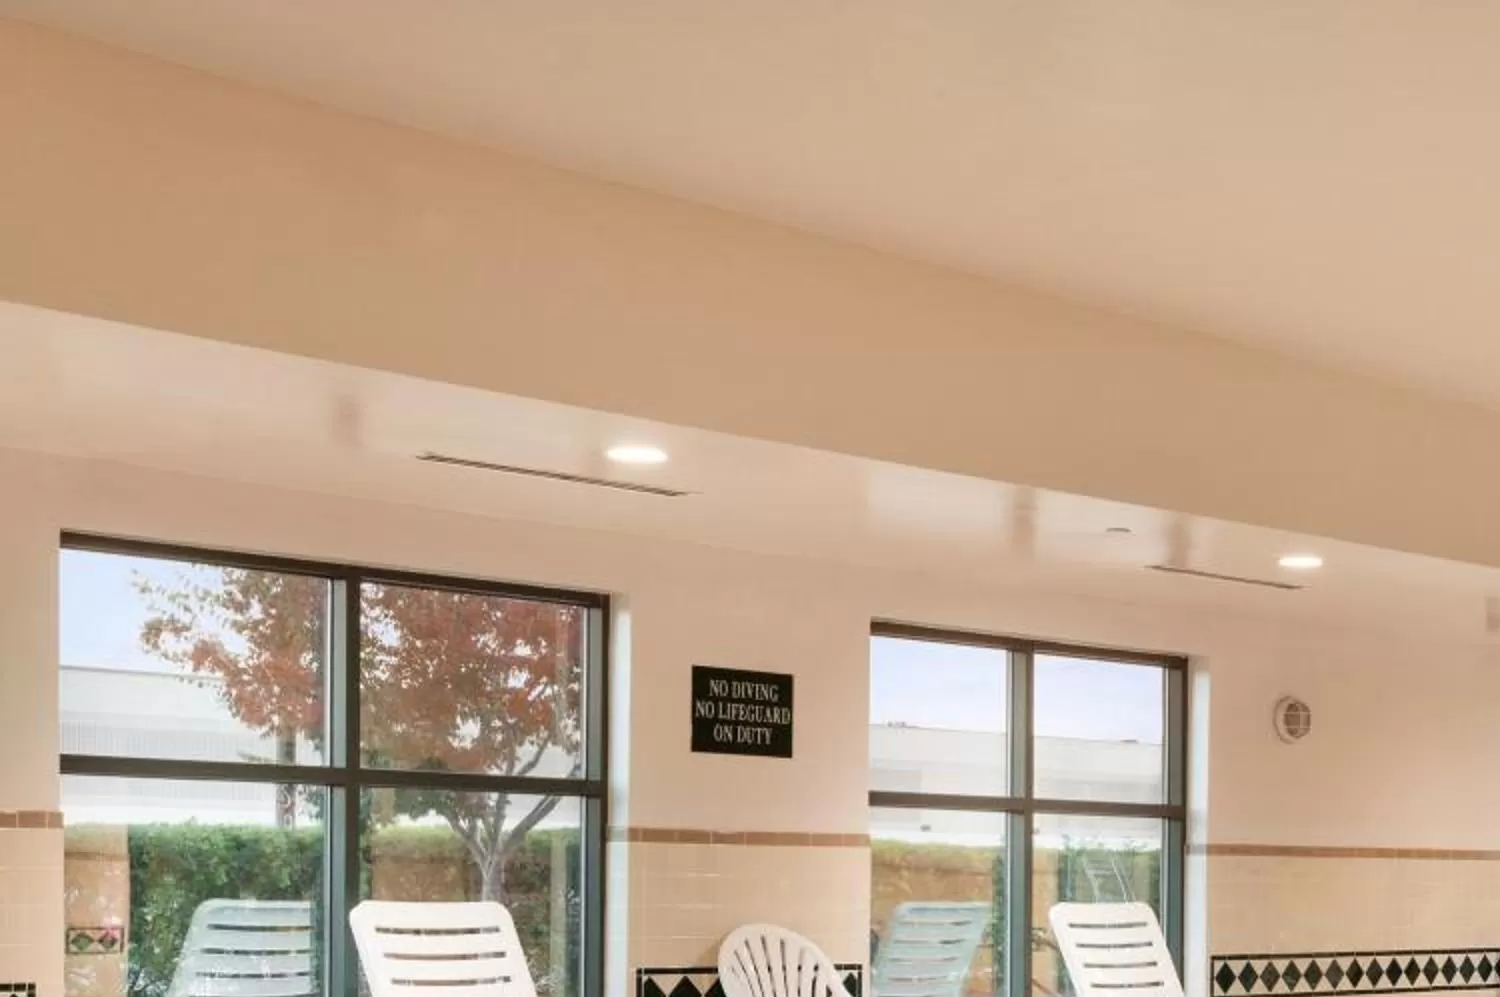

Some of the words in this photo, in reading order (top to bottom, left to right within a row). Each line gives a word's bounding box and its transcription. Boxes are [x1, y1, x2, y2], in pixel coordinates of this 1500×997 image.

[709, 678, 729, 697] NO
[732, 680, 779, 702] DIVING
[695, 698, 715, 719] NO
[718, 700, 791, 725] LIFEGUARD
[713, 723, 733, 743] ON
[736, 725, 773, 745] DUTY
